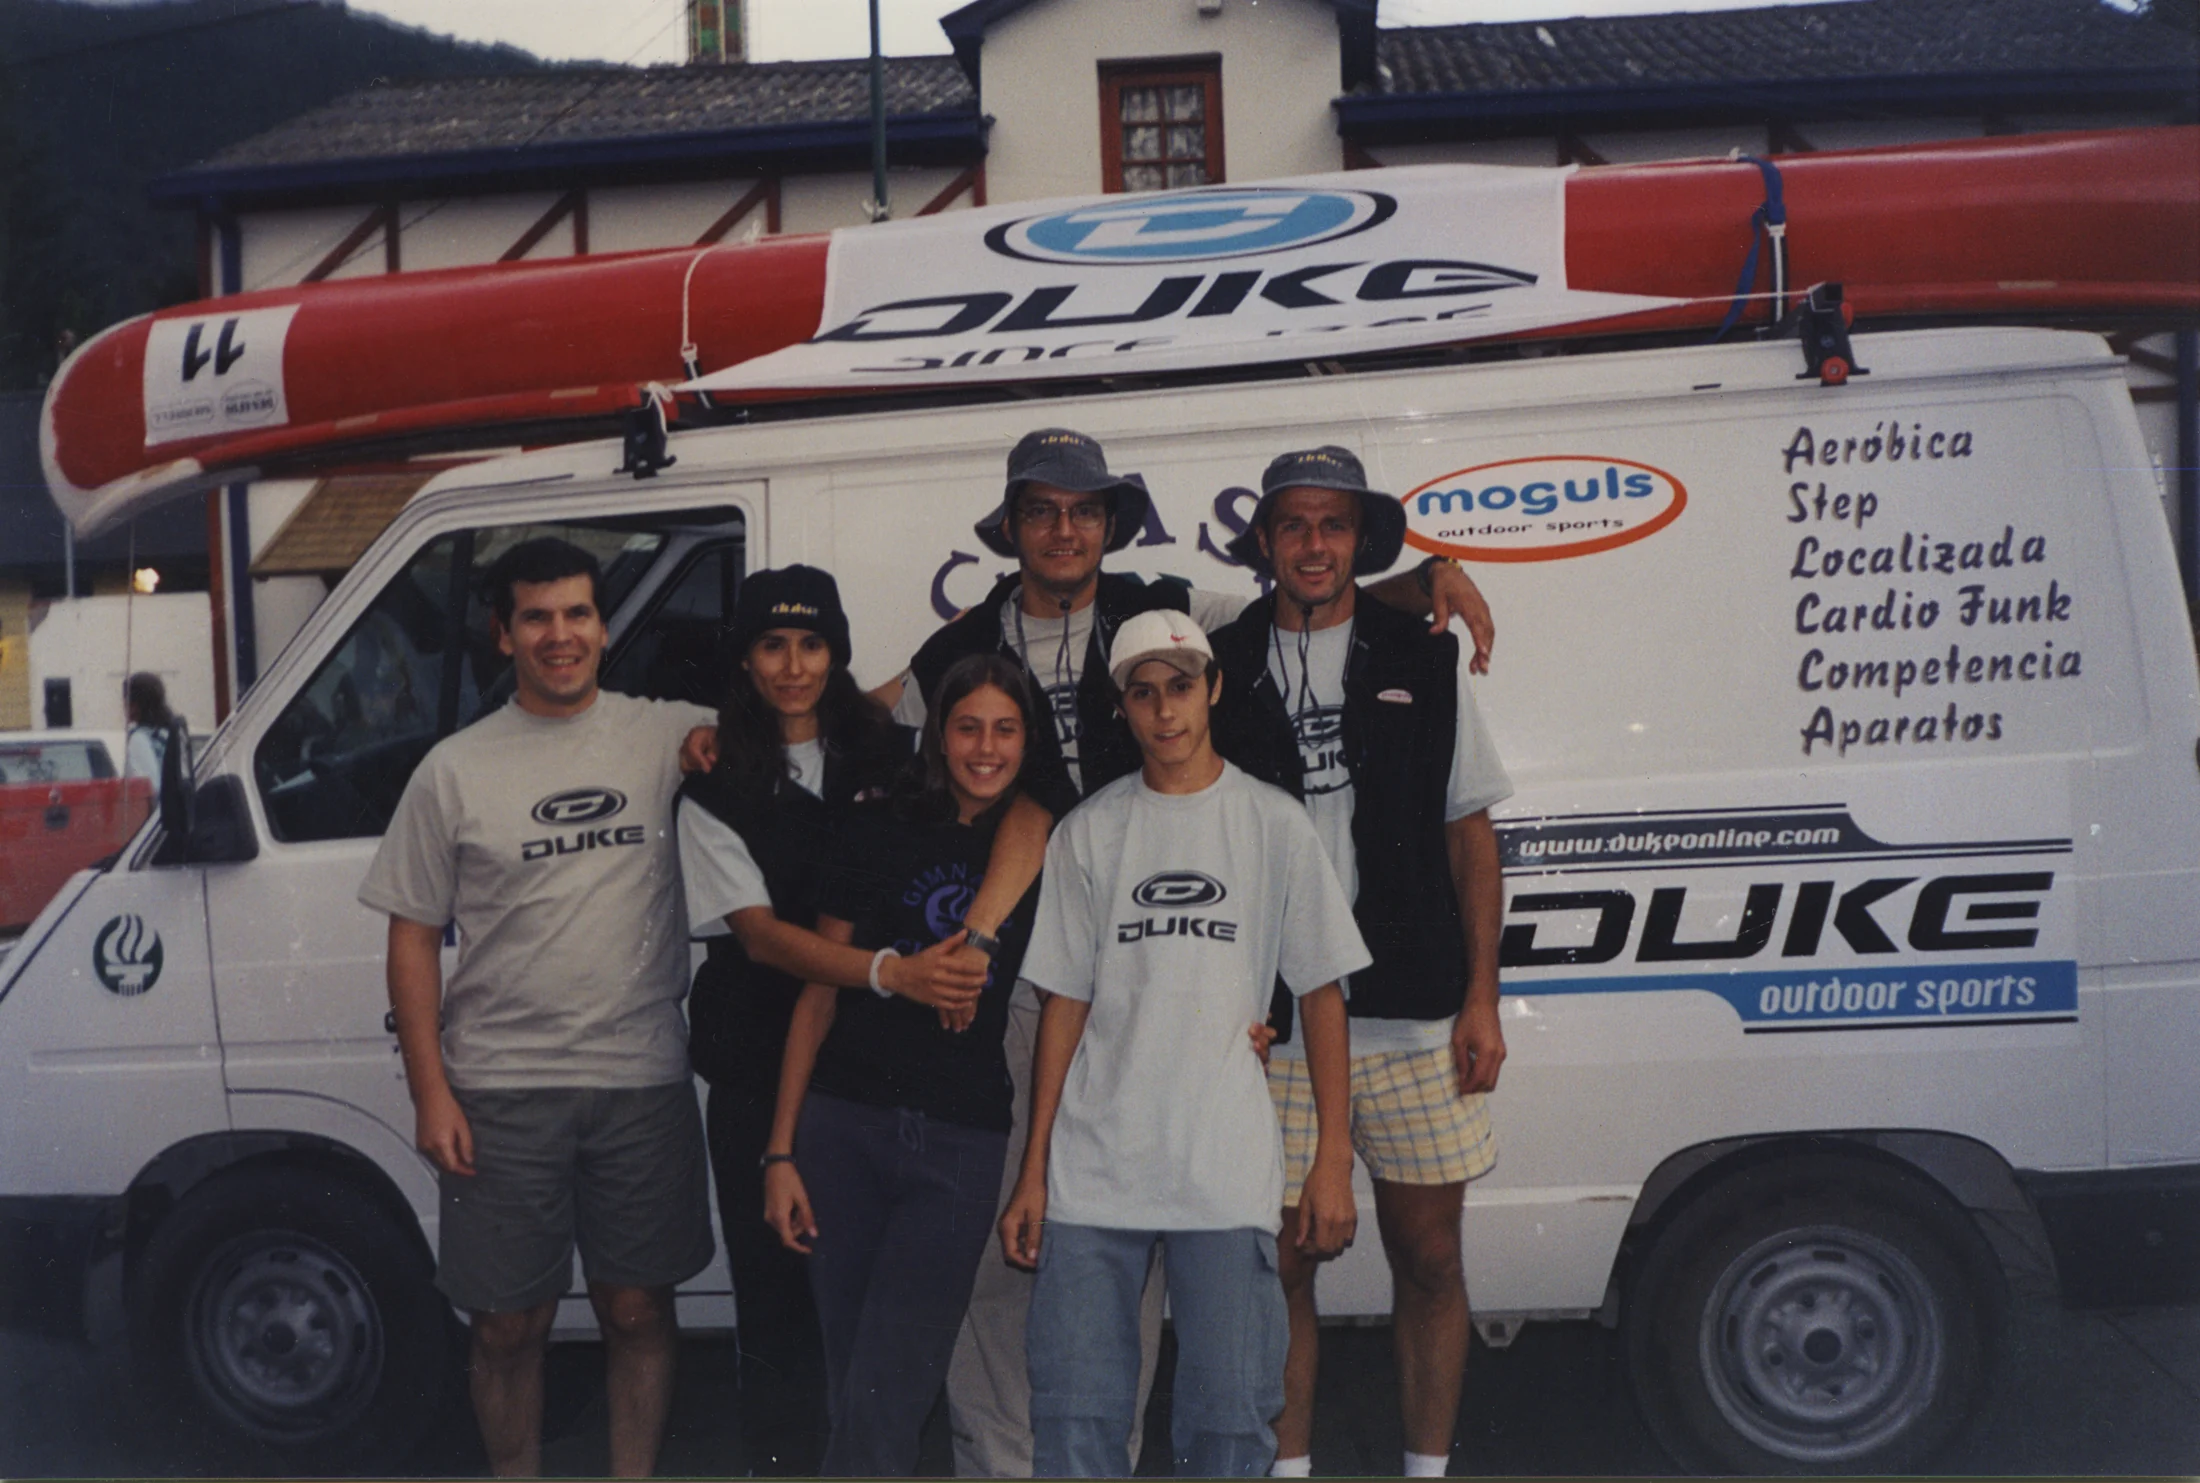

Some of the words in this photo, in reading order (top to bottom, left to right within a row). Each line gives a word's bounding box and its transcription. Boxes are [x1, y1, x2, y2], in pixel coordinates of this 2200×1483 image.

[808, 259, 1539, 344] DUKE
[182, 317, 246, 383] 11
[1782, 420, 1974, 475] Aeróbica
[1417, 466, 1654, 516] moguls
[1787, 481, 1878, 529] Step
[1437, 524, 1534, 539] outdoor
[1546, 518, 1625, 533] sports
[1790, 524, 2046, 579] Localizada
[1795, 588, 1940, 634] Cardio
[1957, 579, 2072, 626] Funk
[1798, 640, 2082, 698] Competencia
[1800, 702, 2004, 756] Aparatos
[521, 825, 645, 861] DUKE
[1519, 827, 1840, 857] www.dukeonline.com
[1118, 916, 1238, 943] DUKE
[1500, 871, 2054, 967] DUKE
[1760, 977, 1907, 1014] outdoor
[1915, 974, 2037, 1014] sports
